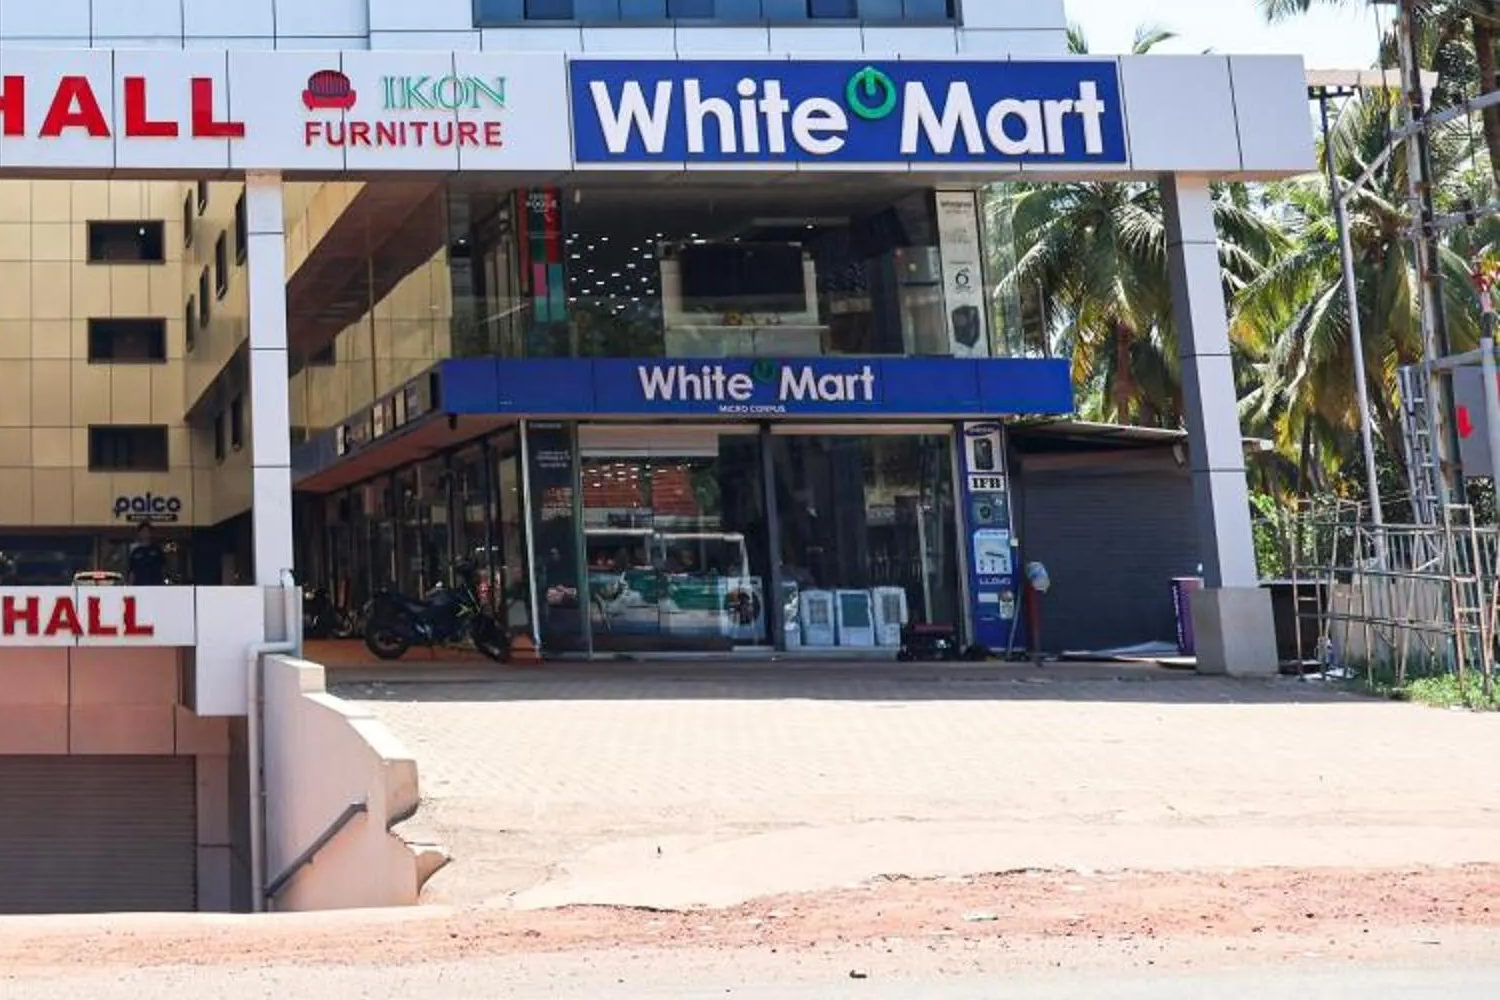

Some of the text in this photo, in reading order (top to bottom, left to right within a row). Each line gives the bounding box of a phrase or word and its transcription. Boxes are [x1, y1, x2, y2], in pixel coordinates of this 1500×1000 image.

[381, 75, 508, 110] IKON
[304, 120, 504, 148] FURNITURE
[589, 78, 1106, 156] White Mart
[638, 364, 875, 401] White Mart
[973, 477, 1001, 489] IFB
[3, 596, 155, 637] HALL
